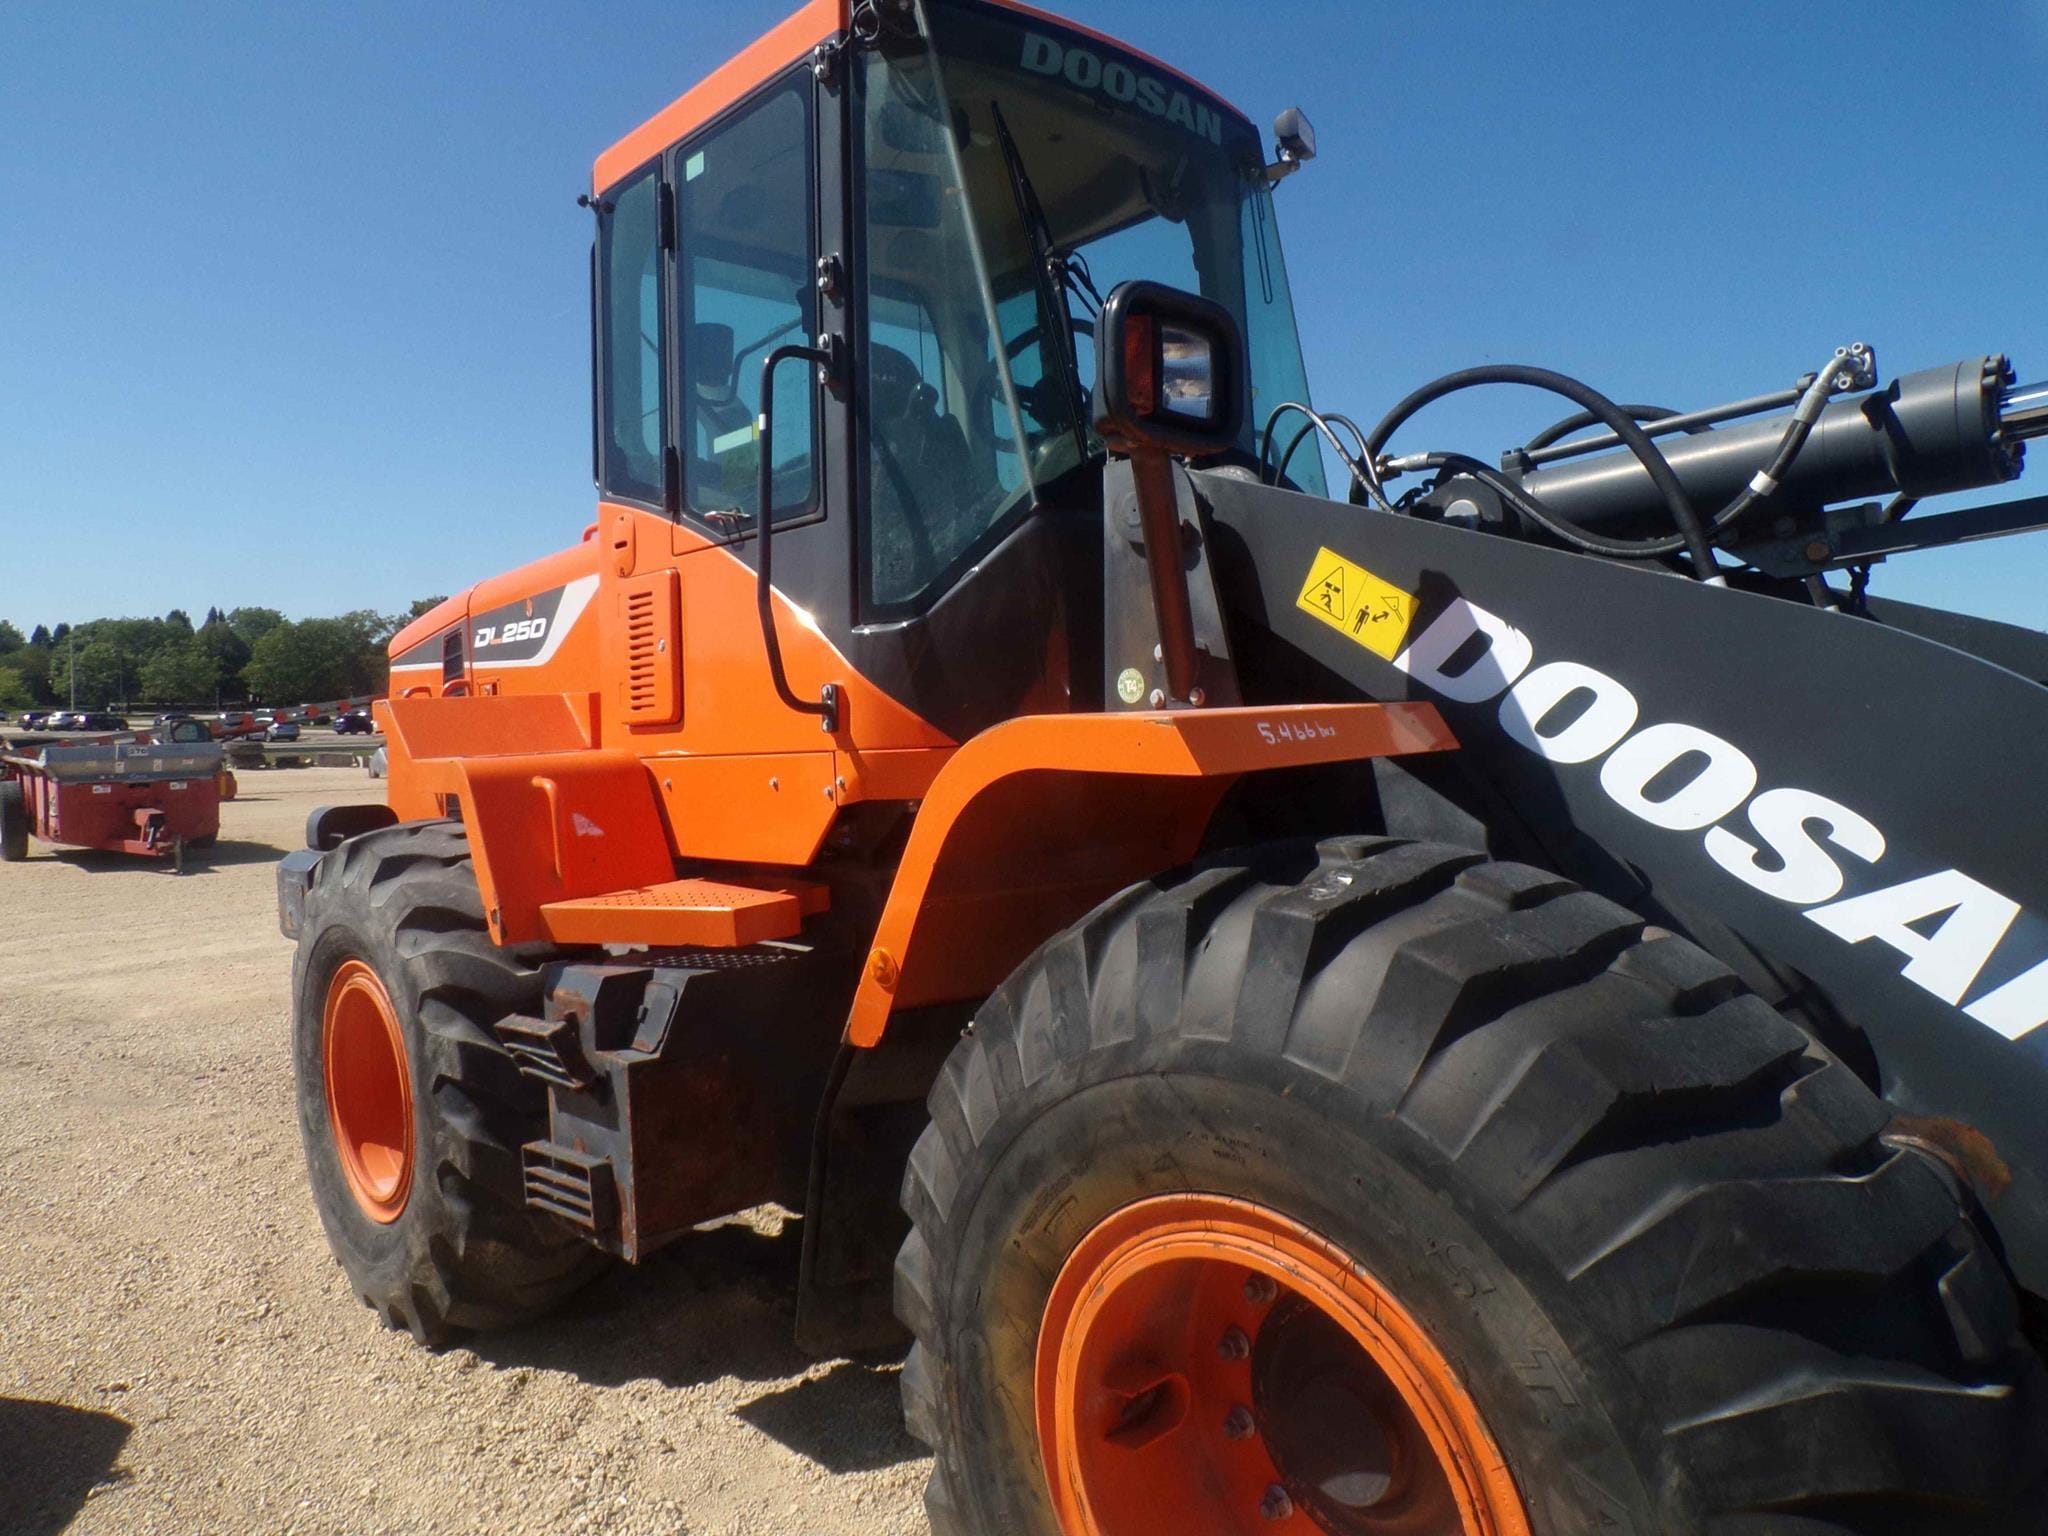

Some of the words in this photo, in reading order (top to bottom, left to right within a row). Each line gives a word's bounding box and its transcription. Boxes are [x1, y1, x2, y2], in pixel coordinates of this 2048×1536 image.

[1020, 32, 1222, 146] DOOSAN
[474, 617, 547, 648] DL250
[1393, 598, 2048, 1040] DOOSA
